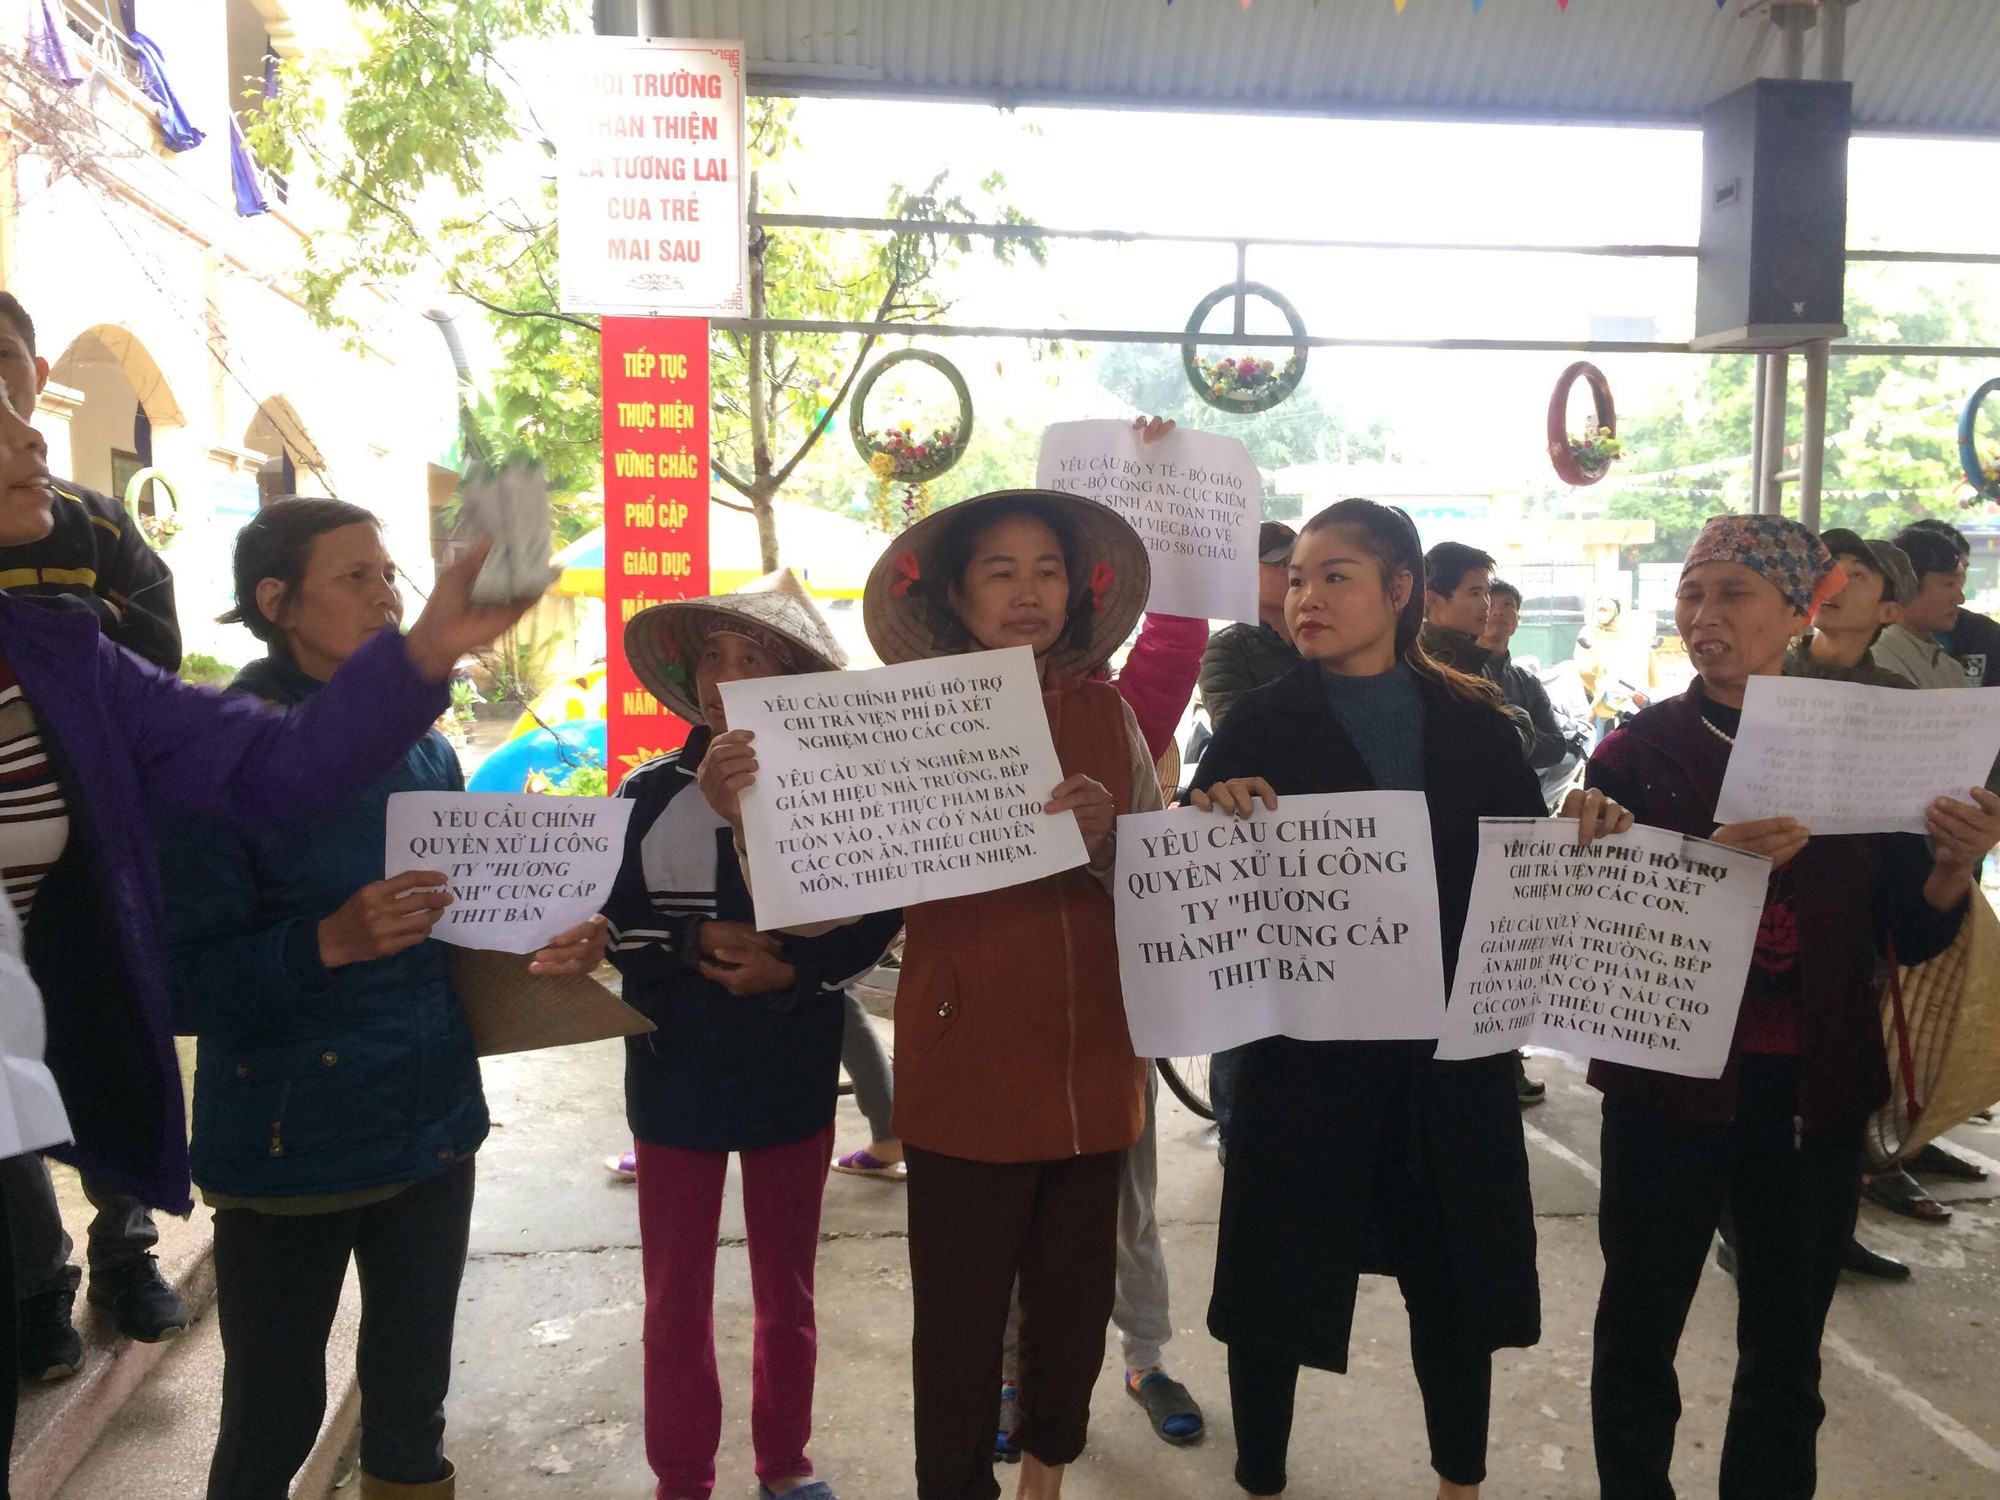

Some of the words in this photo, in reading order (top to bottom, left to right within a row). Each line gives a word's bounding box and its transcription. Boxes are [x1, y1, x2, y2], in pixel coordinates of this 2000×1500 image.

[633, 68, 721, 99] TRƯỜNG
[653, 111, 717, 145] THIỆN
[694, 158, 727, 182] LAI
[660, 191, 699, 222] TRẺ
[608, 239, 649, 261] MAI
[660, 239, 700, 262] SAU
[623, 346, 655, 378] TIẾP
[660, 354, 687, 384] TỤC
[618, 401, 655, 433] THỰC
[660, 399, 694, 433] HIỆN
[615, 449, 654, 478] VỮNG
[659, 446, 698, 478] CHẮC
[1060, 456, 1086, 471] YÊU
[1123, 461, 1140, 477] BỘ
[1146, 463, 1155, 474] Y
[1160, 463, 1177, 477] TẾ
[1189, 467, 1206, 484] BỘ
[1210, 472, 1242, 489] GIÁO
[1111, 477, 1152, 492] CÔNG
[1184, 487, 1211, 502] CỤC
[625, 495, 654, 528] PHỔ
[659, 499, 688, 533] CẬP
[1105, 495, 1139, 509] SINH
[1145, 500, 1162, 512] AN
[1168, 503, 1204, 518] TOÀN
[1208, 509, 1244, 526] THỰC
[1141, 537, 1169, 551] CHO
[1173, 542, 1194, 555] 580
[1198, 544, 1237, 560] CHÁU
[1215, 528, 1232, 543] VỆ
[623, 547, 657, 576] GIÁO
[662, 552, 691, 581] DỤC
[623, 687, 657, 715] NĂM
[763, 695, 798, 712] YÊU
[804, 693, 839, 709] CẦU
[844, 690, 896, 706] CHÍNH
[902, 681, 936, 701] PHỦ
[969, 676, 1002, 692] TRỢ
[784, 717, 815, 731] CHI
[819, 710, 854, 728] TRẢ
[858, 711, 897, 727] VIỆN
[902, 702, 930, 720] PHÍ
[935, 700, 957, 716] ĐÃ
[962, 695, 992, 713] XÉT
[798, 732, 868, 750] NGHIỆM
[872, 729, 908, 744] CHO
[912, 723, 945, 739] CÁC
[951, 719, 990, 734] CON.
[777, 769, 814, 788] YÊU
[820, 763, 857, 782] CẦU
[862, 759, 886, 776] XỬ
[891, 758, 910, 773] LÝ
[916, 749, 984, 770] NGHIÊM
[988, 745, 1021, 761] BAN
[776, 790, 827, 810] GIÁM
[832, 784, 877, 803] HIỆU
[882, 776, 917, 795] NHÀ
[921, 769, 997, 789] TRƯỜNG,
[1000, 761, 1029, 778] BẾP
[433, 807, 477, 827] YÊU
[484, 803, 526, 828] CẦU
[532, 804, 596, 827] CHÍNH
[790, 813, 814, 831] ĂN
[821, 809, 854, 826] KHI
[888, 796, 937, 815] THỰC
[834, 826, 872, 845] VÀO
[956, 809, 966, 826] Ý
[1008, 802, 1041, 818] CHO
[410, 833, 488, 858] QUYỀN
[495, 833, 526, 854] XỬ
[530, 833, 548, 853] LÍ
[554, 833, 608, 852] CÔNG
[791, 854, 830, 873] CÁC
[835, 848, 874, 866] CON
[880, 843, 908, 860] ĂN,
[912, 832, 964, 854] THIẾU
[969, 821, 1035, 845] CHUYÊN
[1141, 829, 1198, 857] YÊU
[1207, 811, 1266, 848] CẦU
[1276, 810, 1376, 842] CHÍNH
[452, 863, 478, 877] TY
[486, 860, 570, 877] "HƯƠNG
[800, 873, 848, 894] MÔN,
[853, 862, 907, 885] THIẾU
[911, 853, 971, 874] TRÁCH
[976, 844, 1036, 865] NHIỆM.
[1128, 861, 1222, 899] QUYỀN
[1229, 850, 1270, 880] XỬ
[1279, 851, 1306, 877] LÍ
[1317, 847, 1407, 876] CÔNG
[1504, 840, 1528, 857] YÊU
[1606, 845, 1644, 863] PHỦ
[1686, 859, 1727, 882] TRỢ
[497, 884, 554, 900] CUNG
[559, 880, 596, 898] CẤP
[1510, 864, 1530, 878] CHI
[1534, 861, 1558, 877] TRẢ
[1564, 863, 1596, 880] VIỆN
[1599, 865, 1627, 882] PHÍ
[1633, 871, 1659, 888] ĐÃ
[1665, 877, 1705, 896] XÉT
[1181, 899, 1220, 924] TY
[1229, 887, 1350, 913] "HƯƠNG
[1513, 883, 1562, 900] NGHIỆM
[1566, 884, 1593, 897] CHO
[1597, 885, 1638, 904] CÁC
[1643, 894, 1688, 914] CON.
[1139, 928, 1248, 963] THÀNH"
[1257, 924, 1337, 947] CUNG
[1347, 918, 1409, 946] CẤP
[1490, 916, 1515, 933] YÊU
[1561, 911, 1581, 928] LÝ
[1585, 917, 1665, 944] NGHIÊM
[1671, 933, 1711, 952] BAN
[1481, 937, 1515, 954] GIÁM
[1581, 936, 1667, 966] TRƯỜNG,
[1674, 955, 1711, 973] BẾP
[1483, 958, 1503, 973] ĂN
[1505, 958, 1526, 972] KHI
[1209, 958, 1271, 991] THỊT
[1473, 997, 1499, 1015] CÁC
[1503, 997, 1528, 1011] CON
[1548, 993, 1605, 1015] THIẾU
[1610, 1005, 1693, 1032] CHUYÊN
[1603, 979, 1615, 996] Ý
[1666, 996, 1709, 1016] CHO
[1473, 1016, 1504, 1035] MÔN,
[1542, 1012, 1606, 1036] TRÁCH
[1611, 1026, 1681, 1051] NHIỆM.
